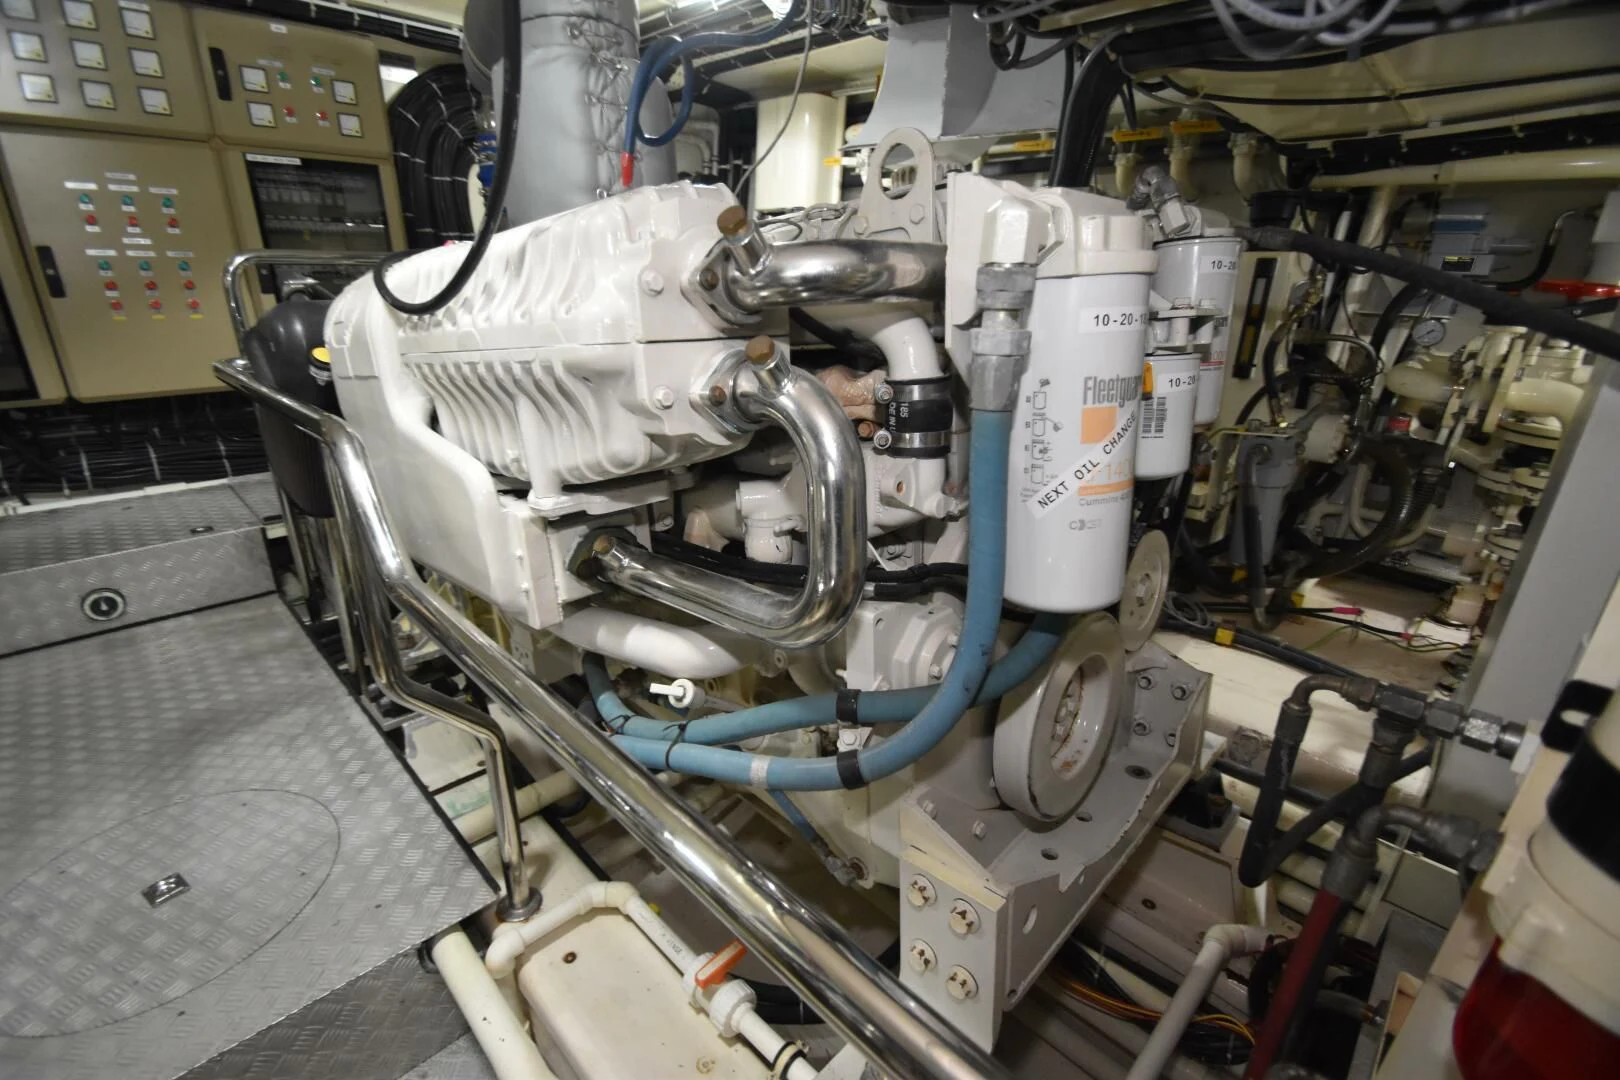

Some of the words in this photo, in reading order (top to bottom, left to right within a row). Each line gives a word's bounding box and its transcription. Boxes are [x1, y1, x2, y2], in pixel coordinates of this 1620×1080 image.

[1037, 481, 1070, 510] NEXT
[1074, 459, 1100, 481] OIL
[1102, 410, 1136, 455] CHANGE
